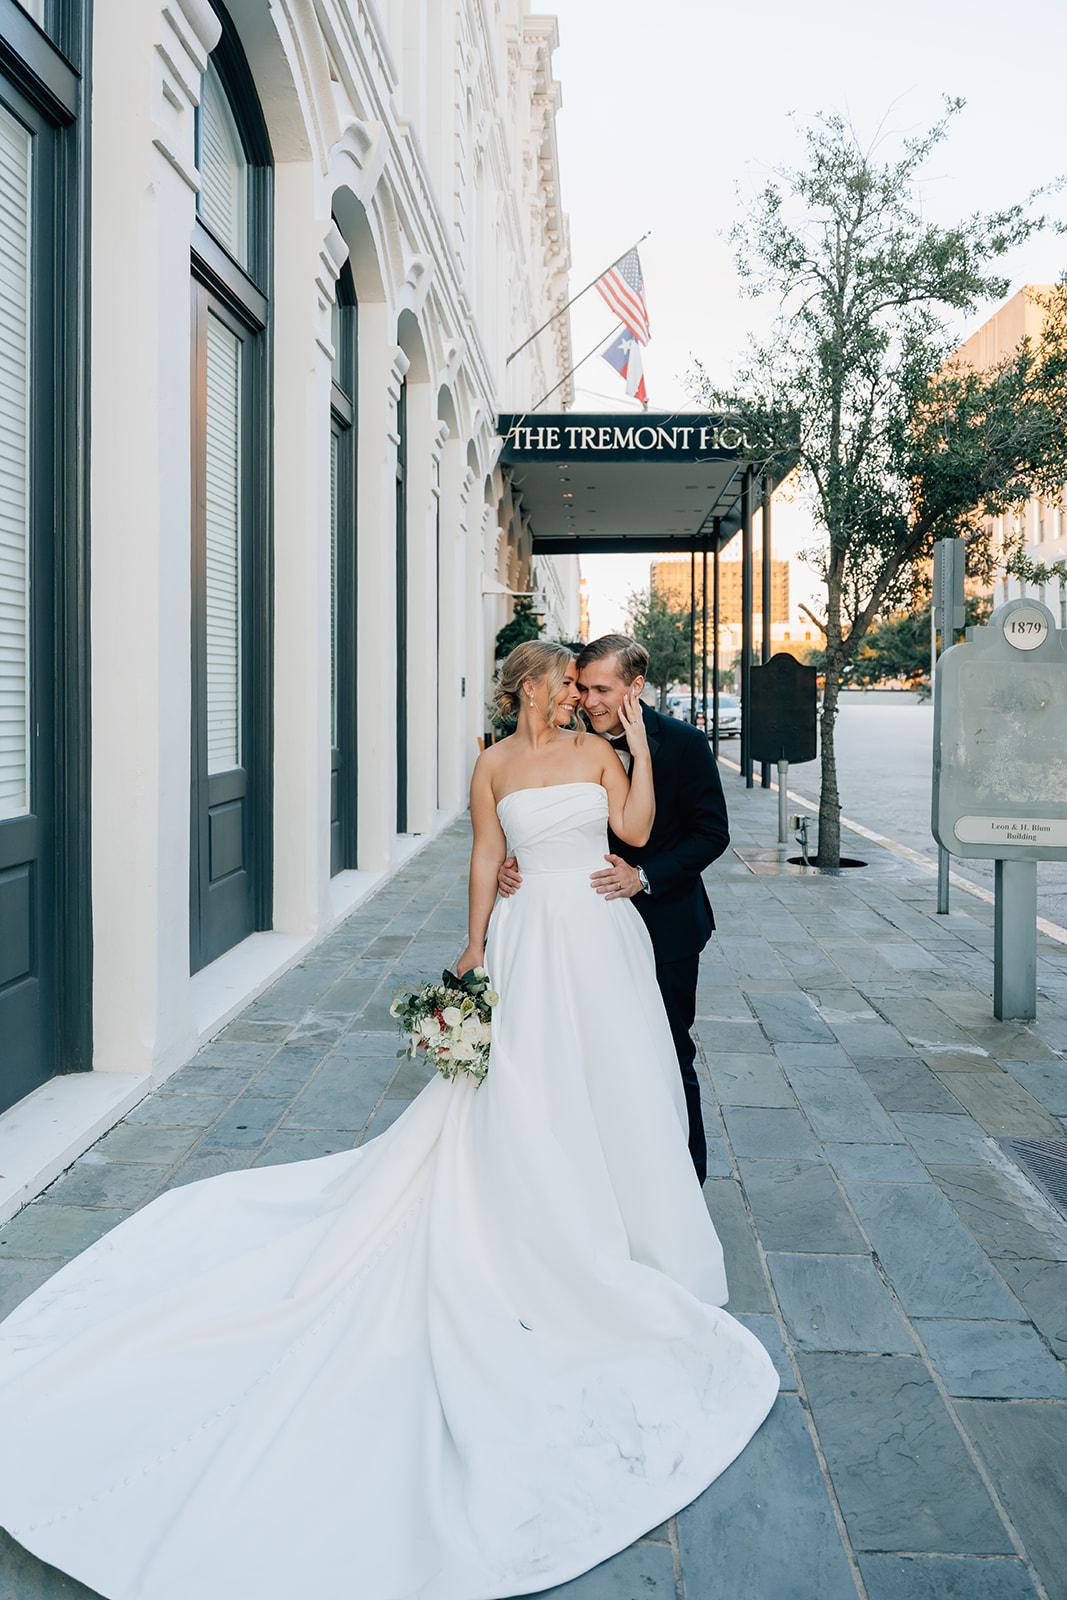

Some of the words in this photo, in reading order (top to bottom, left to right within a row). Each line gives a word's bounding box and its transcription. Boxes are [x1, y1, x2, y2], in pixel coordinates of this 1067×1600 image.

[510, 427, 561, 450] THE
[564, 427, 695, 450] TREMONT
[1010, 621, 1042, 634] 1879
[1006, 833, 1037, 841] Building
